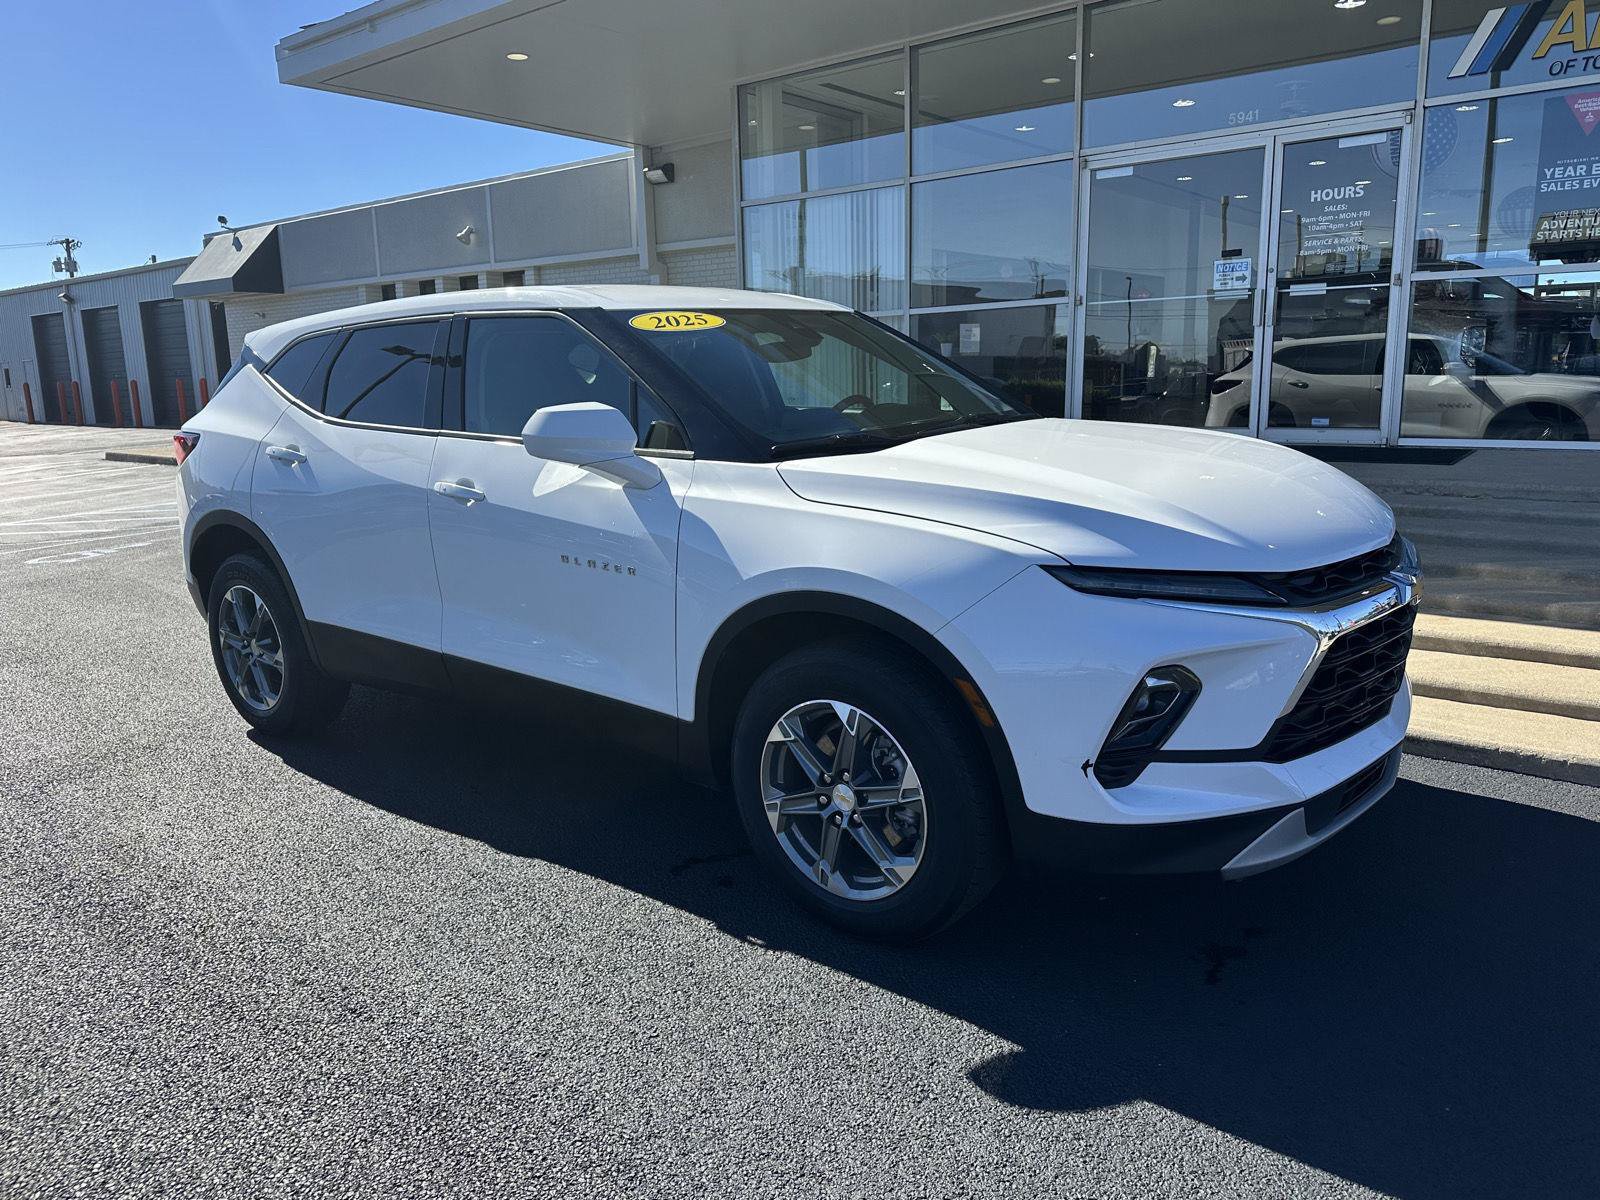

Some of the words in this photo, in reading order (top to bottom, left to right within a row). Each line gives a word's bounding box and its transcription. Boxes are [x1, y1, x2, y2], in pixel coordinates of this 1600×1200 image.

[1531, 0, 1600, 60] A
[1549, 58, 1577, 76] OF
[1228, 109, 1259, 125] 5941
[1543, 164, 1587, 179] YEAR
[1540, 180, 1580, 192] SALES
[1583, 178, 1600, 188] EV
[1310, 185, 1365, 202] HOURS
[1324, 203, 1348, 212] SALES:
[1554, 210, 1579, 218] YOUR
[1339, 210, 1371, 220] MON-FRI
[1541, 216, 1600, 230] ADVENTU
[1536, 229, 1582, 240] STARTS
[1304, 238, 1332, 247] SERVICE
[1337, 244, 1368, 253] MON-FRI
[1217, 262, 1248, 272] NOTICE
[649, 314, 708, 329] 2025
[560, 554, 637, 576] BLAZER
